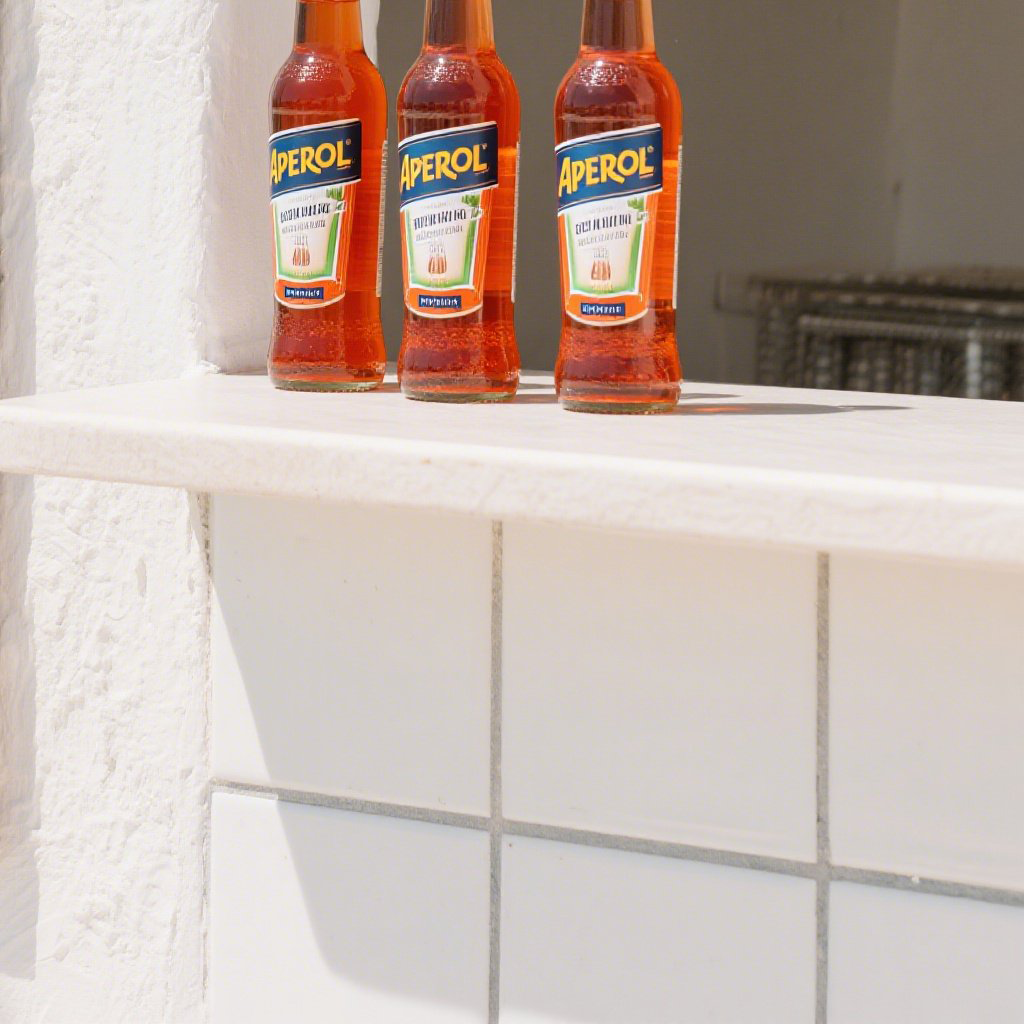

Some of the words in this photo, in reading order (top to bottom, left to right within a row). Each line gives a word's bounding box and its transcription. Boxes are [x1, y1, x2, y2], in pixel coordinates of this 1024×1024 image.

[270, 139, 352, 184] APEROL
[400, 144, 488, 193] APEROL
[558, 145, 655, 197] APEROL
